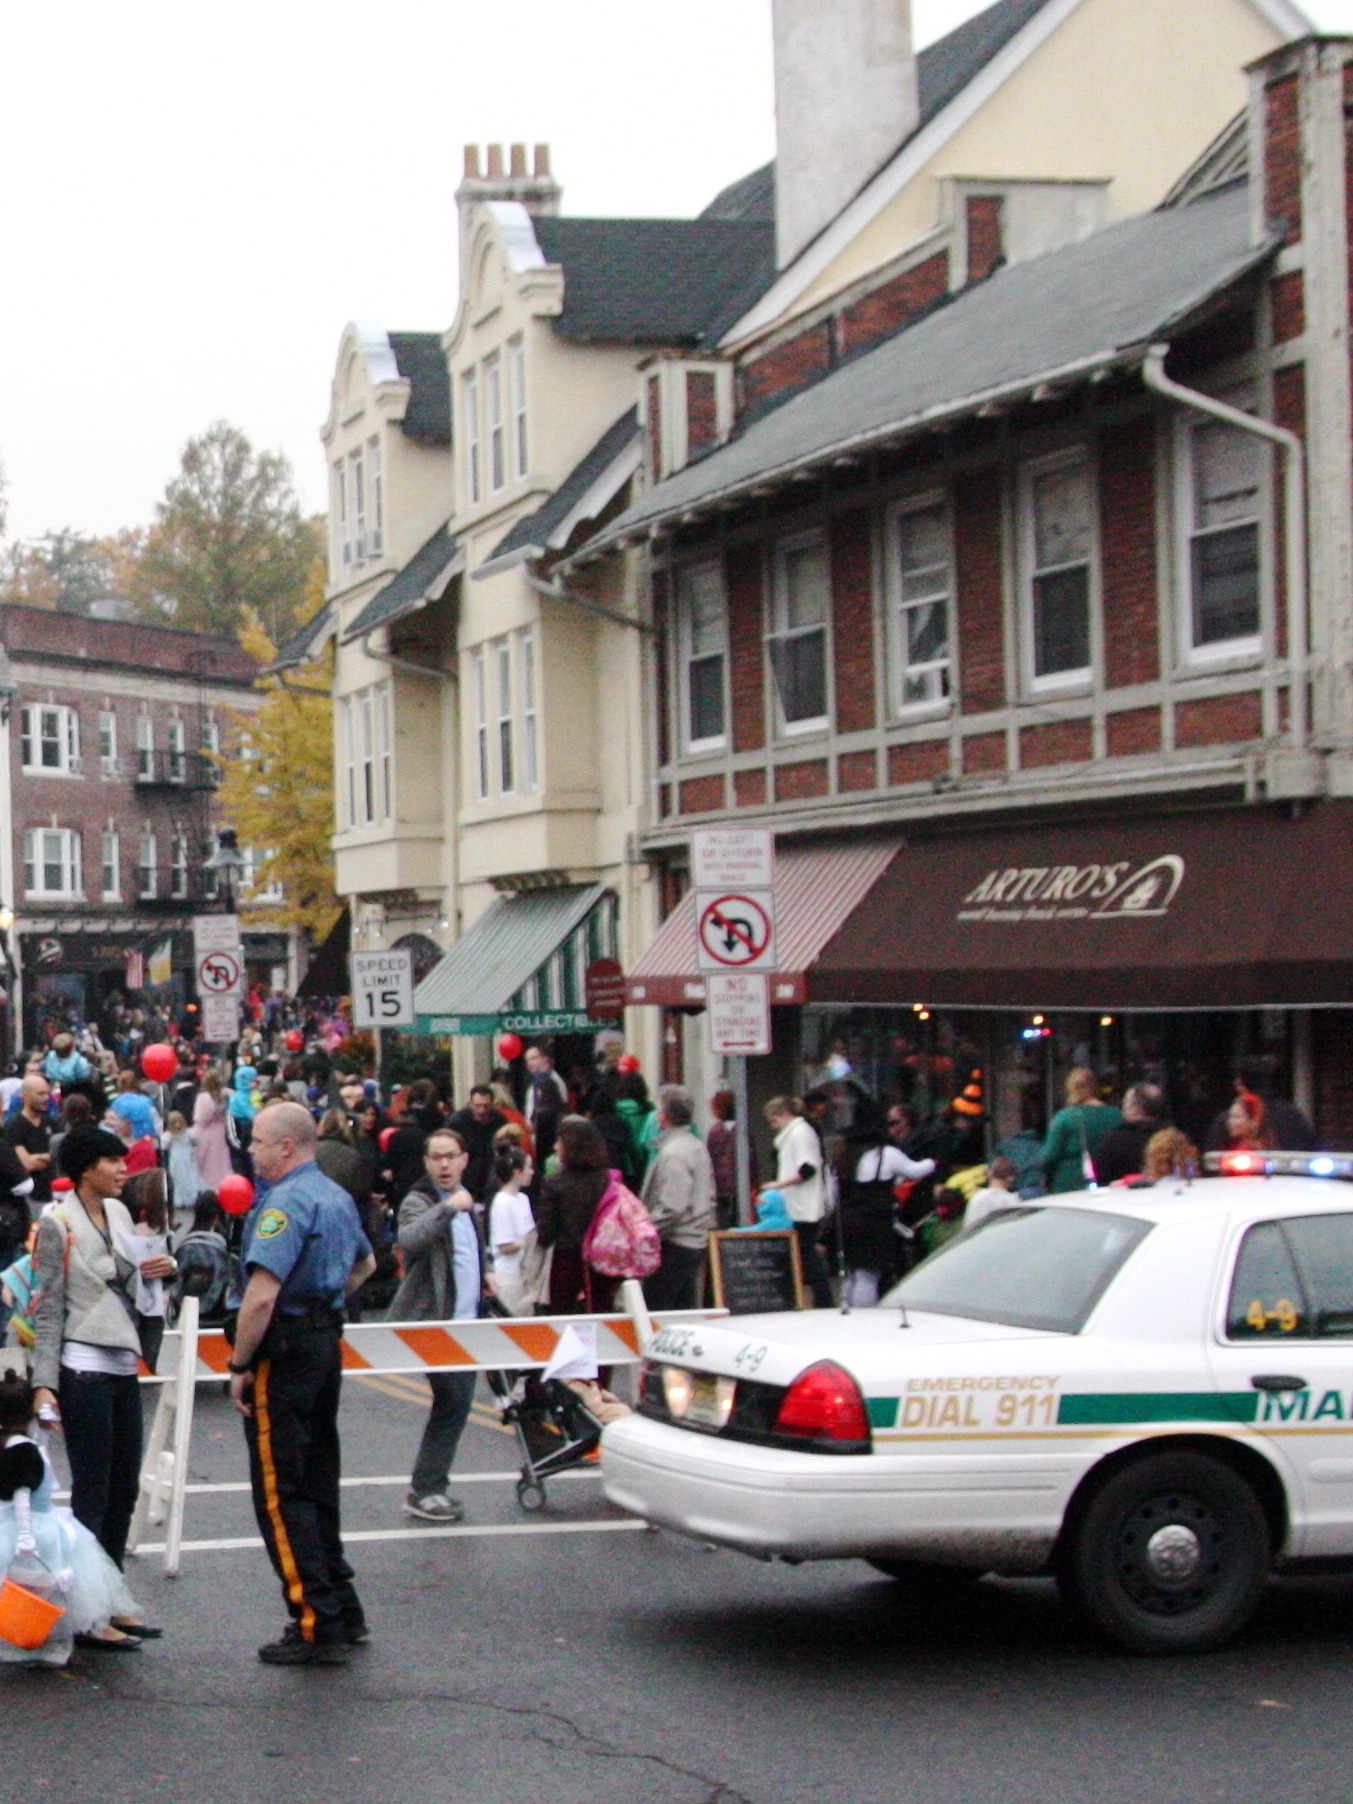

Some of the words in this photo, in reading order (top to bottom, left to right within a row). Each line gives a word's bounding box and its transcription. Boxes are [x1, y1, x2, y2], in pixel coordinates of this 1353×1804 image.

[964, 861, 1130, 902] ARTURO'S
[356, 958, 409, 973] SPEED
[363, 975, 402, 988] LIMIT
[727, 977, 747, 991] NO
[365, 990, 402, 1018] 15
[1247, 1299, 1298, 1331] 4-9
[735, 1342, 768, 1372] 4-9
[907, 1376, 1061, 1392] EMERGENCY
[902, 1395, 982, 1427] DIAL
[996, 1393, 1056, 1426] 911
[1263, 1390, 1353, 1421] MA
